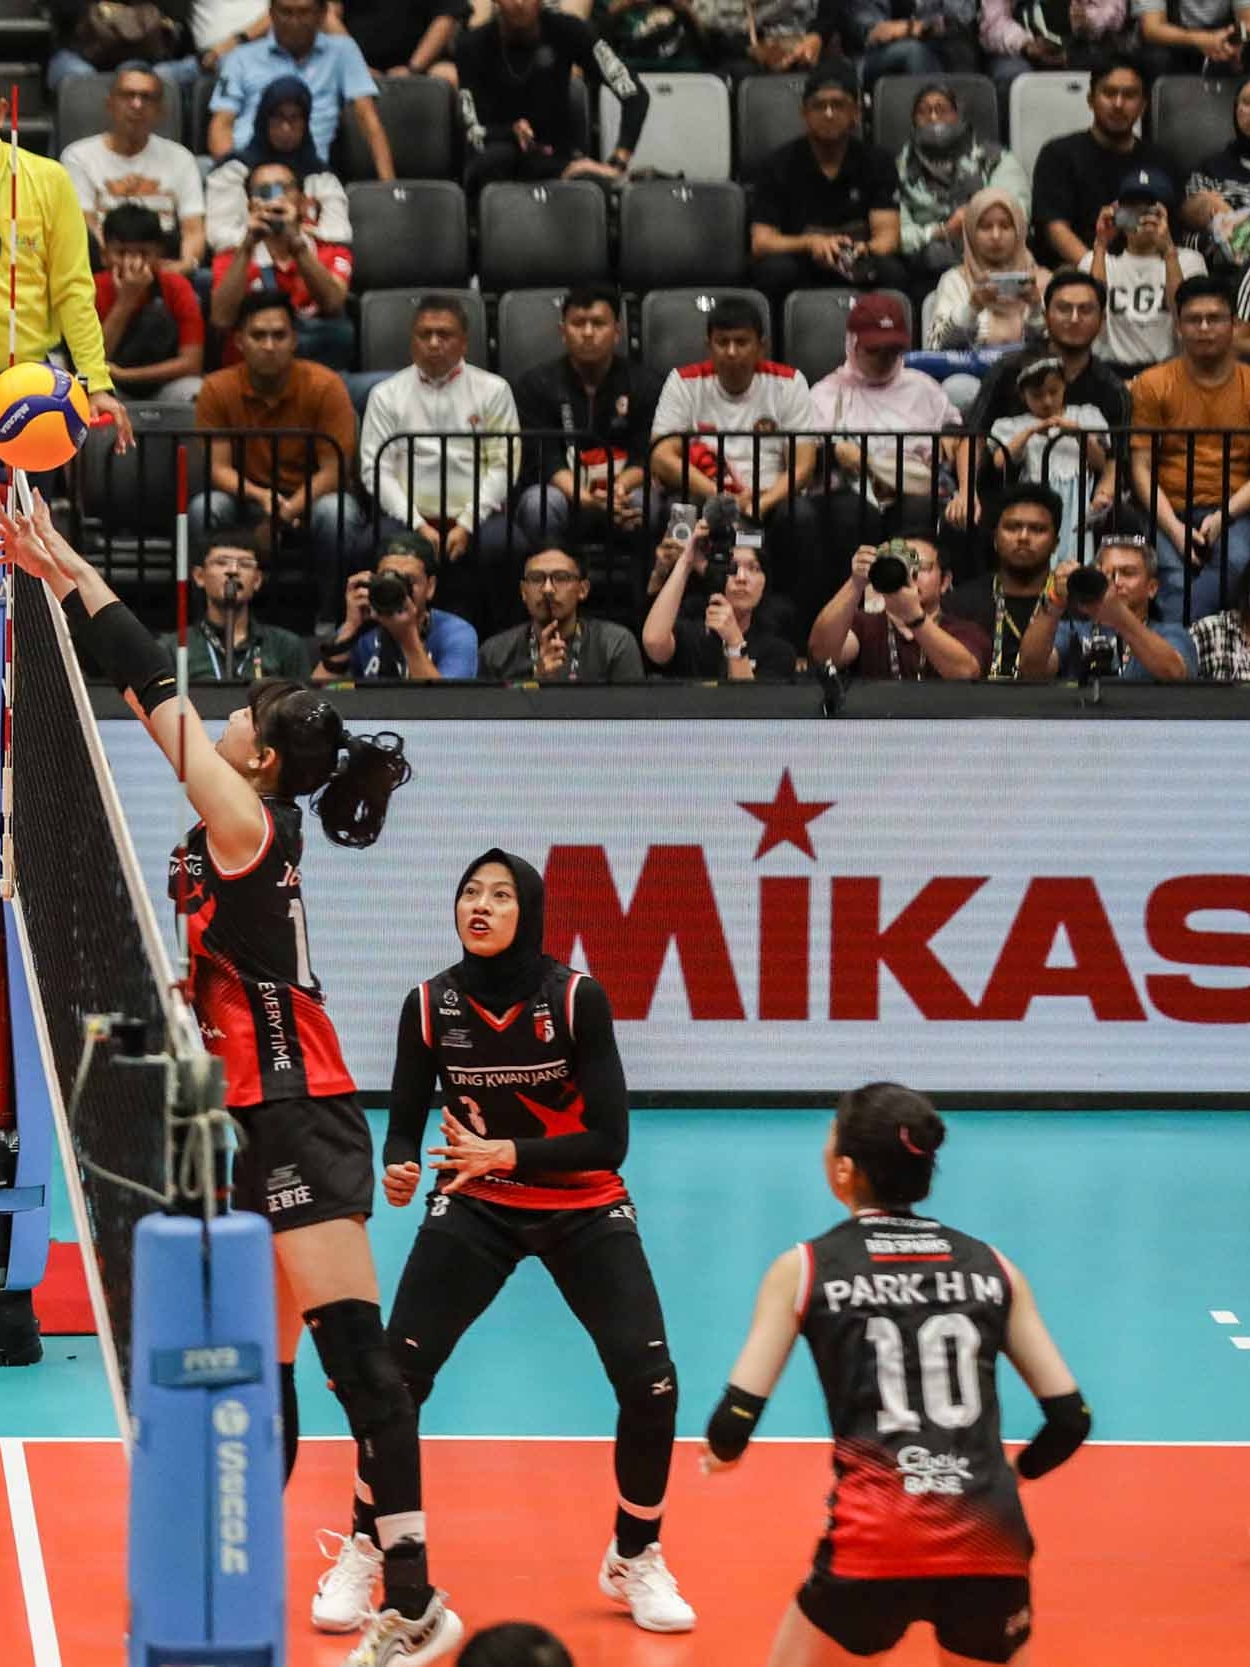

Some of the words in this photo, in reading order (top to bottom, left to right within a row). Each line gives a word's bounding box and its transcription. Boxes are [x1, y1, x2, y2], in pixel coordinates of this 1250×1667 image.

[258, 981, 292, 1072] EVERYTIME
[448, 1072, 483, 1086] UNG
[485, 1071, 529, 1088] KWAN
[529, 1065, 569, 1086] JANG
[823, 1273, 928, 1312] PARK
[935, 1271, 966, 1304] H
[970, 1272, 1003, 1305] M
[865, 1313, 982, 1434] 10
